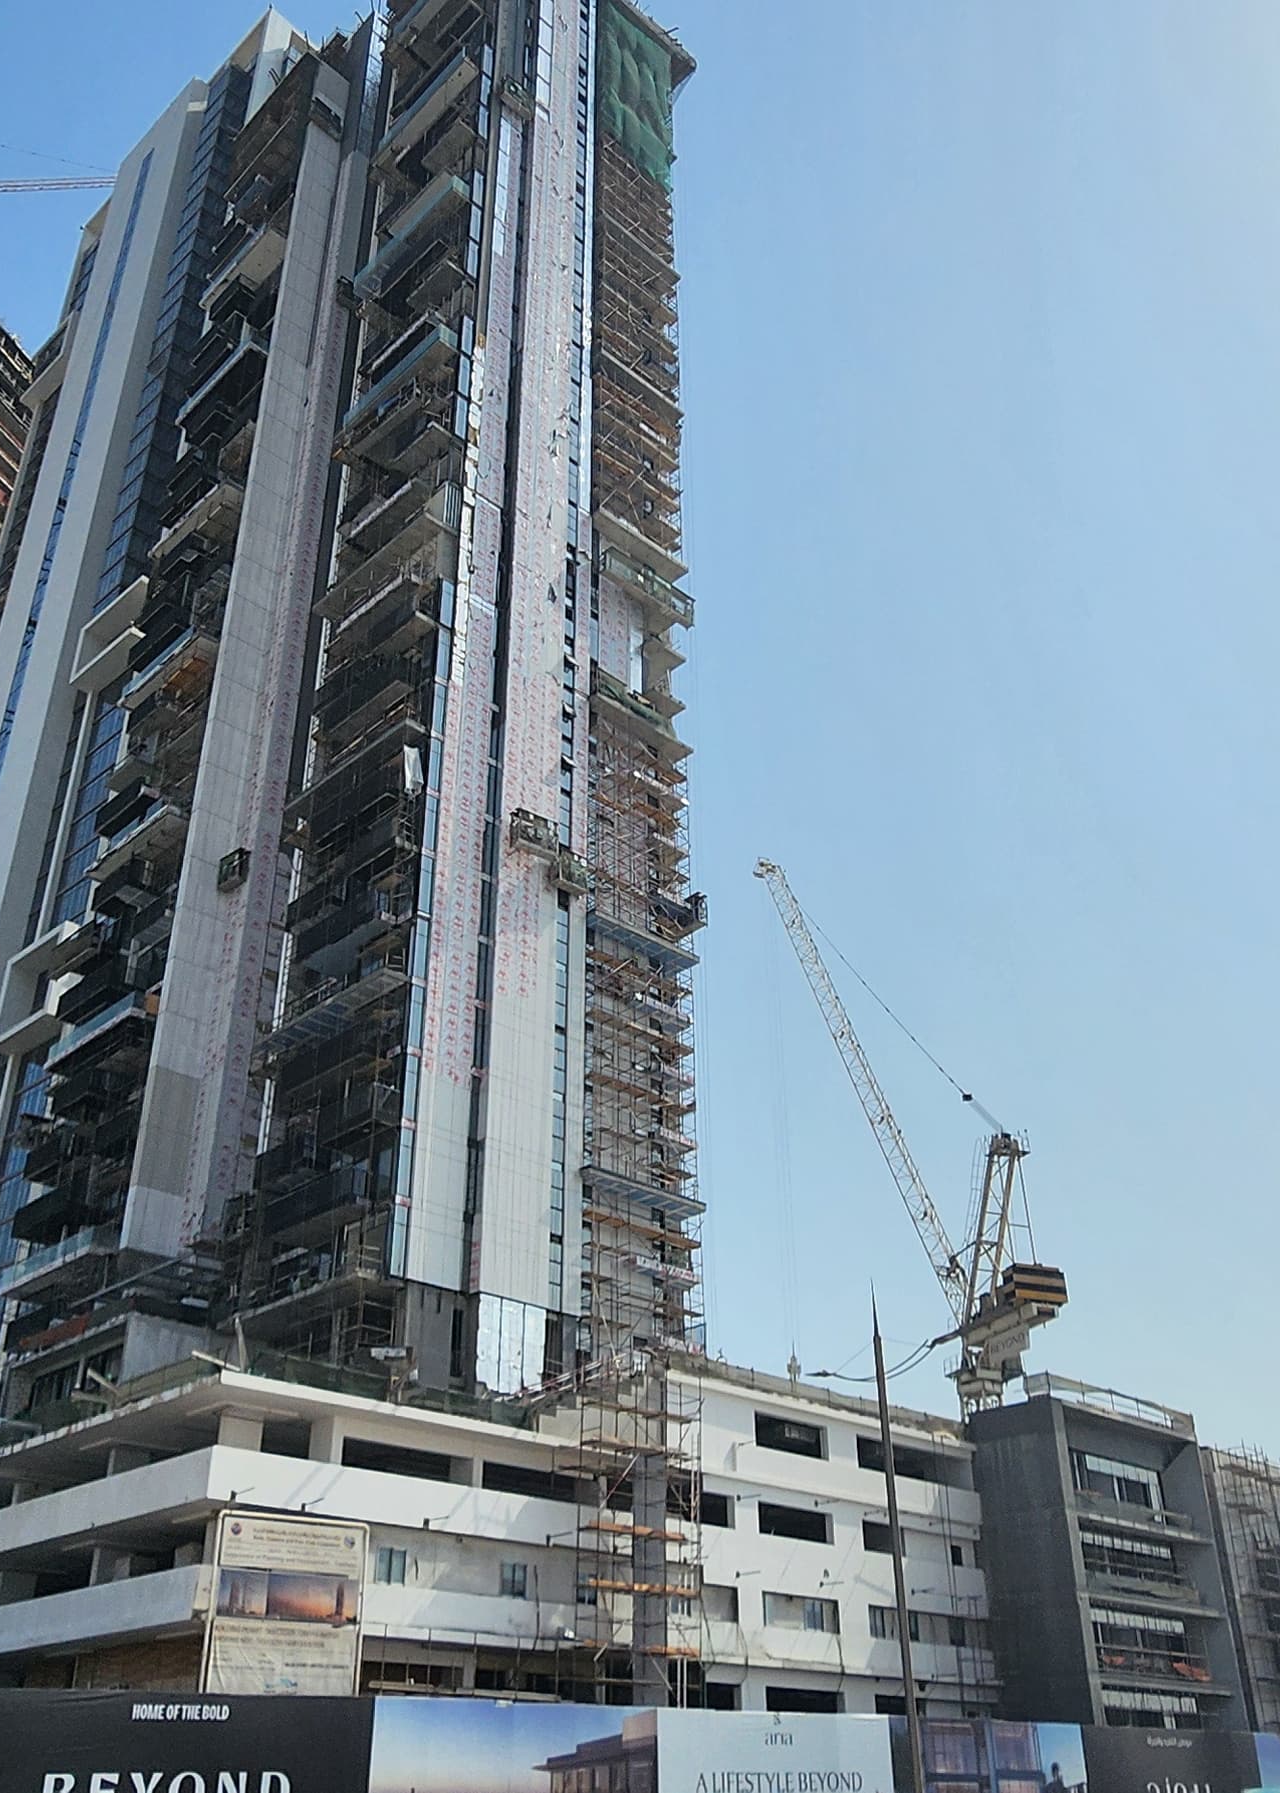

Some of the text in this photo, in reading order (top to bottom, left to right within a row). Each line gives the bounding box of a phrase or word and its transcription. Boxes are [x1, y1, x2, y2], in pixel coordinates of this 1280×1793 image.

[132, 1704, 230, 1721] HOME OF THE BOLD
[696, 1771, 863, 1793] A LIFESTYLE BEYOND
